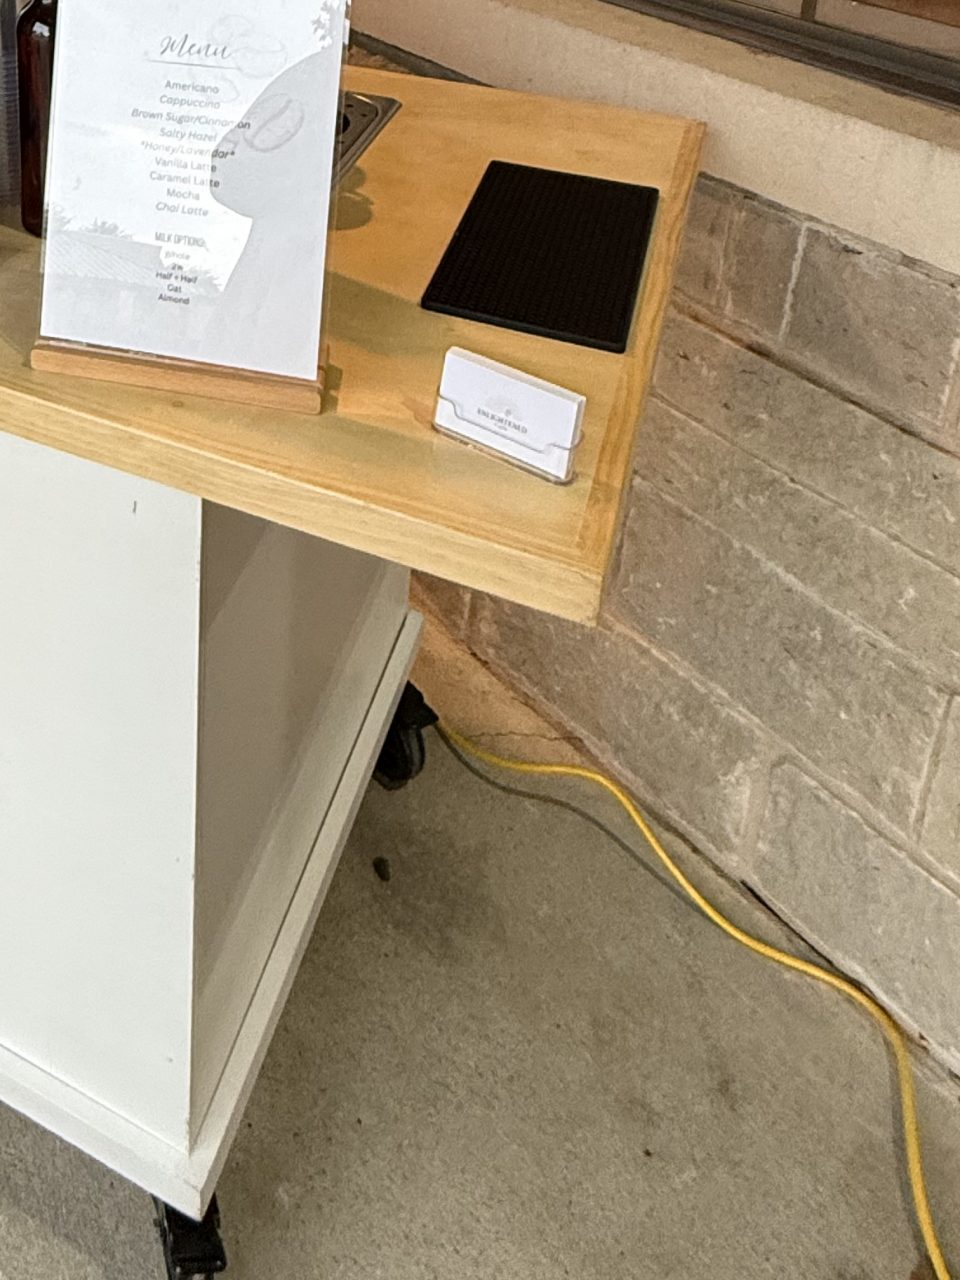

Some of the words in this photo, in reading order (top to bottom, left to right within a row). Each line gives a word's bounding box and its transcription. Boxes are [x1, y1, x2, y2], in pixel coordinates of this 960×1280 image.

[160, 33, 233, 60] Menu
[164, 79, 220, 95] Americano
[159, 94, 221, 110] Cappuccino
[131, 107, 163, 120] Brown
[159, 127, 186, 141] Salty
[187, 131, 218, 142] Hazel
[154, 156, 188, 169] Vanilla
[149, 170, 191, 185] Caramel
[166, 187, 200, 201] Mocha
[181, 204, 209, 216] Latte
[154, 231, 173, 243] MILK
[155, 271, 173, 280] Half
[158, 292, 191, 305] Almond
